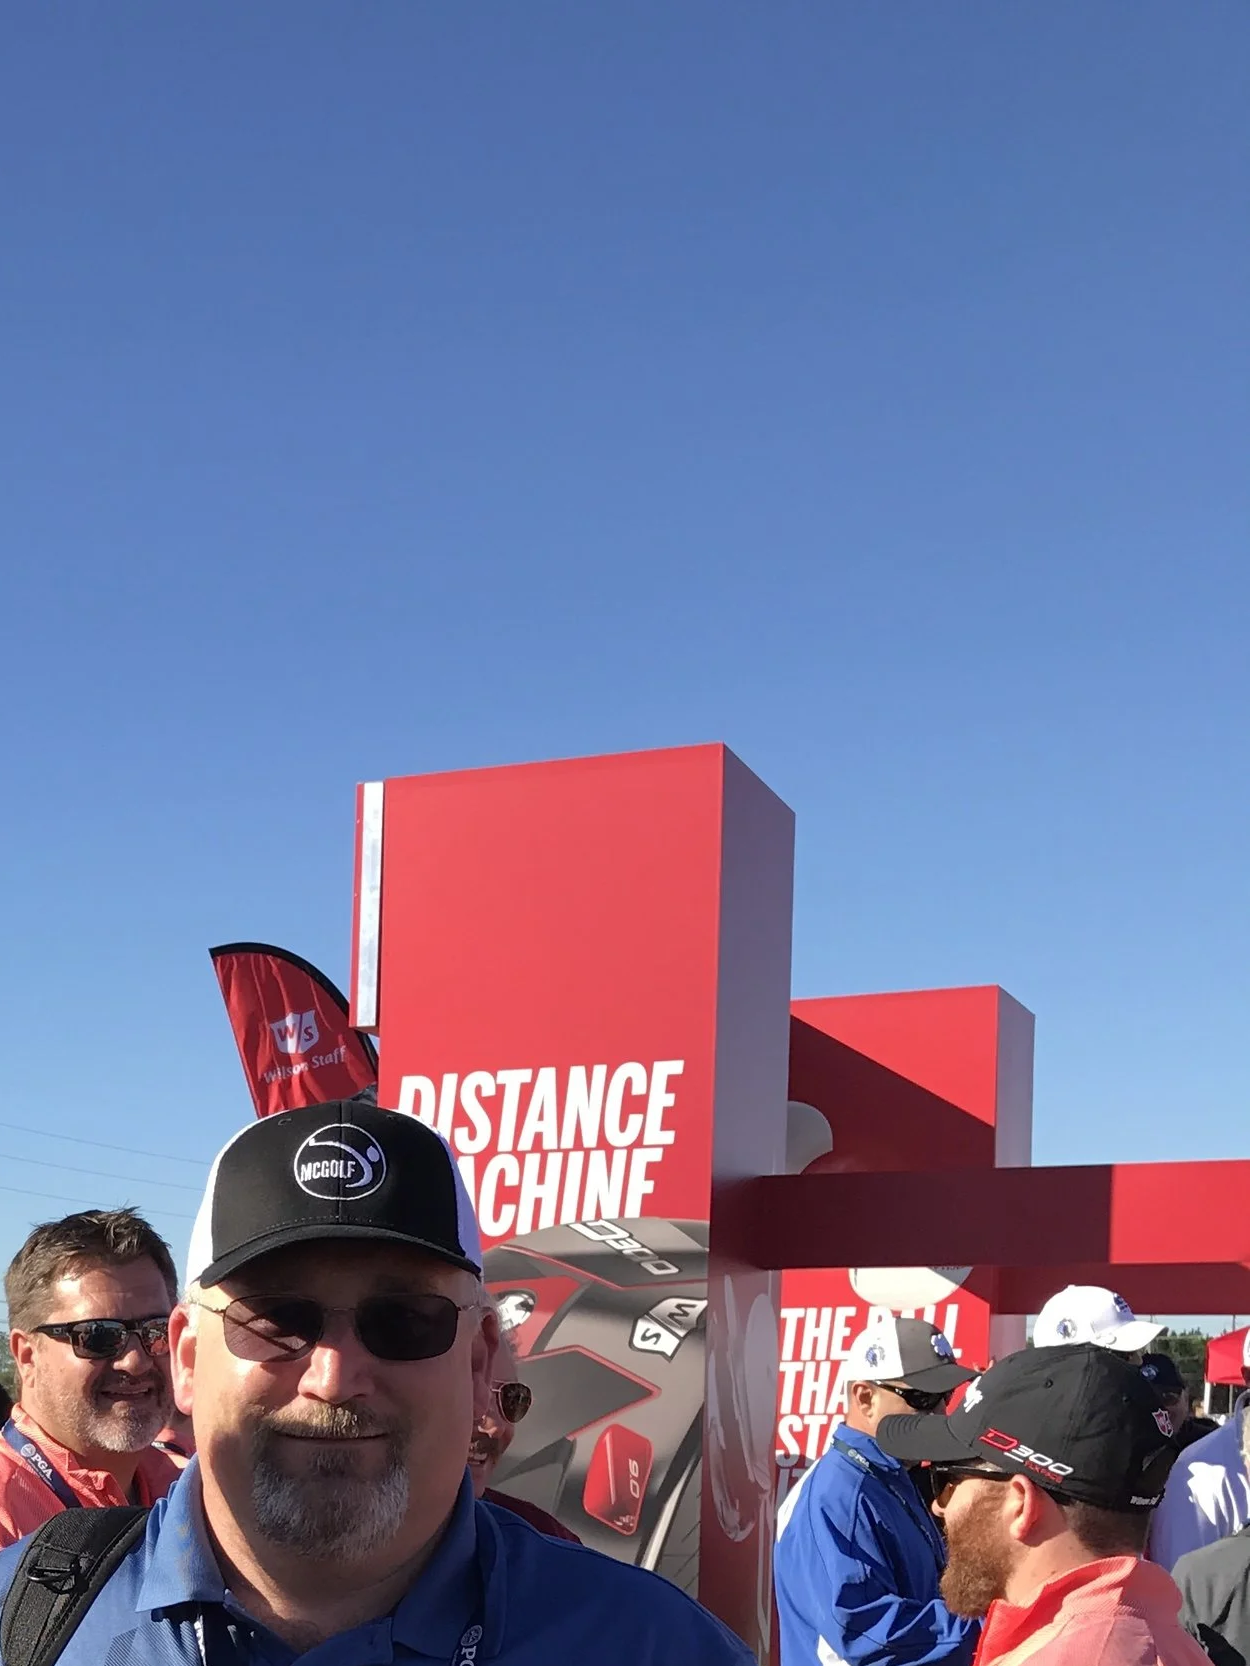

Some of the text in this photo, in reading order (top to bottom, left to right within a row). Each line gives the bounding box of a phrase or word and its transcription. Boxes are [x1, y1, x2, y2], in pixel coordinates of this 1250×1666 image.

[263, 1046, 347, 1085] Wilson Staff
[398, 1060, 684, 1155] DISTANCE
[300, 1160, 356, 1183] MCGOLF
[780, 1306, 857, 1361] THE
[779, 1361, 849, 1414] THA
[33, 1454, 54, 1481] PGA
[855, 1454, 870, 1468] PGA
[979, 1428, 1074, 1476] D300
